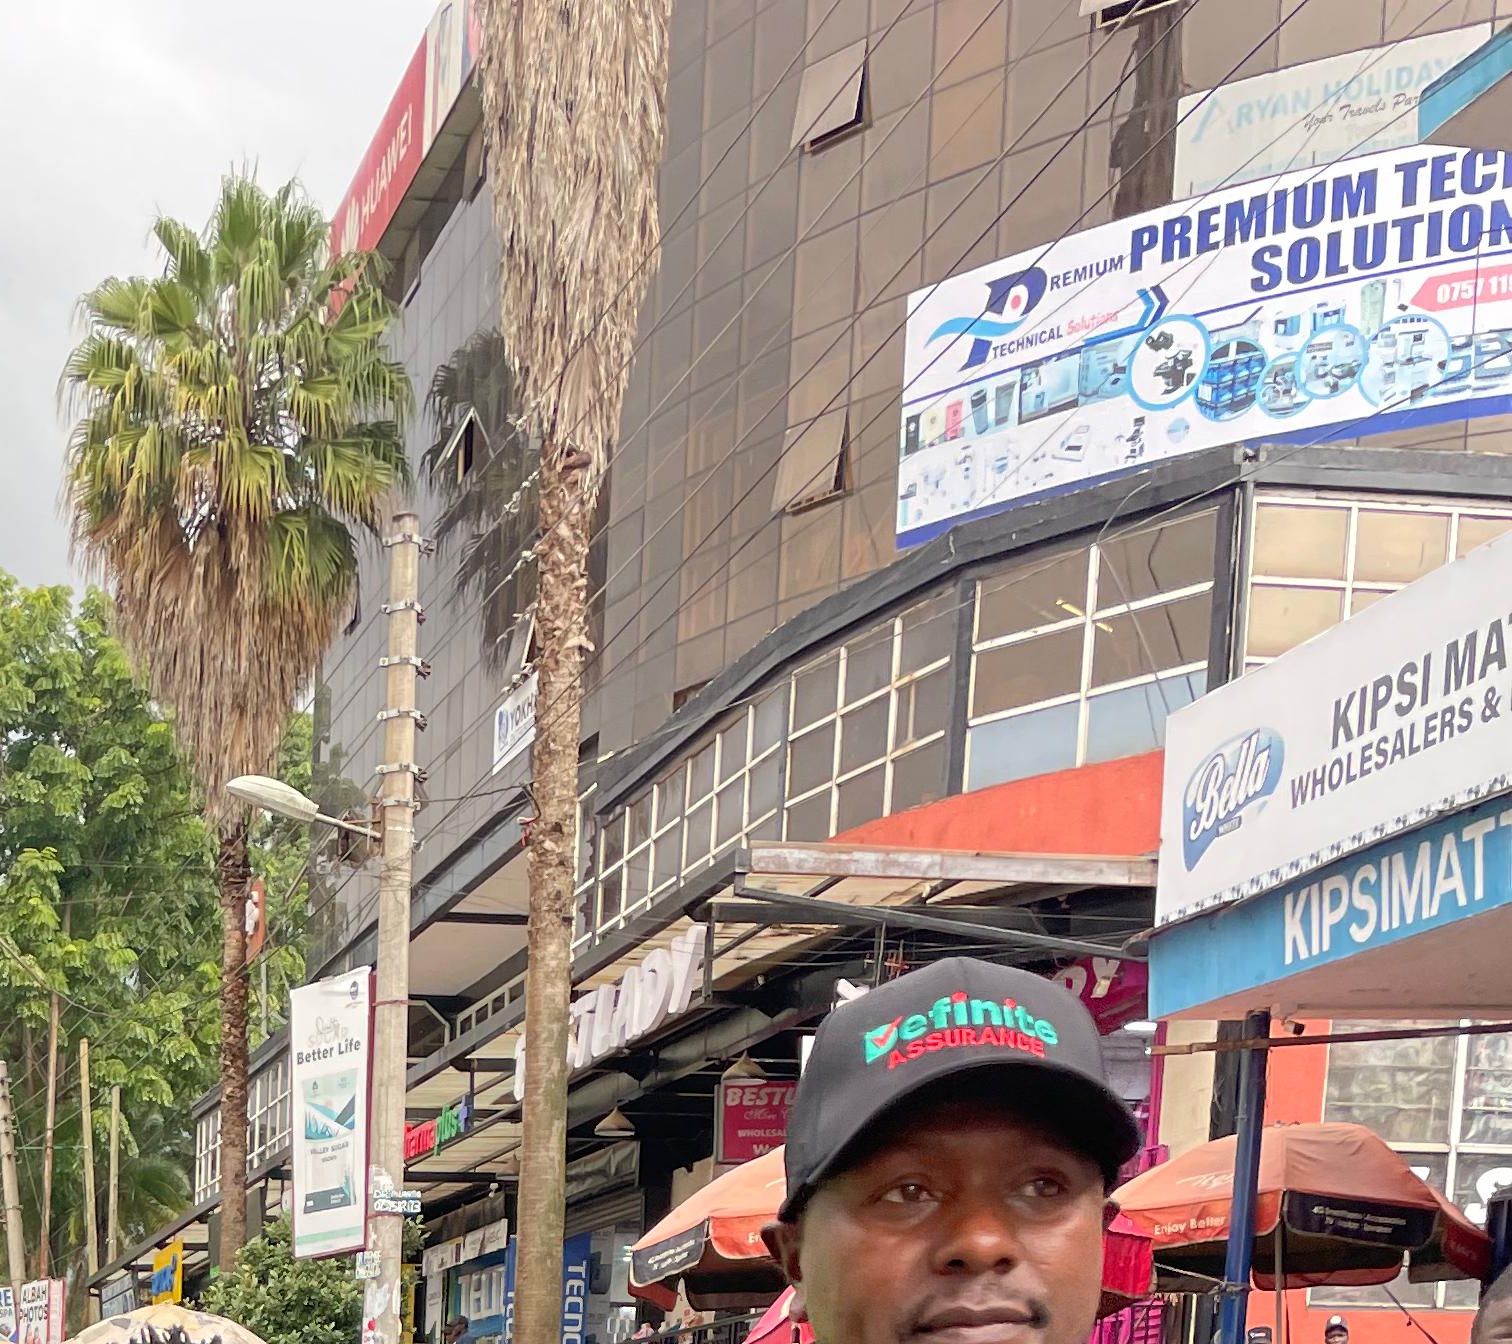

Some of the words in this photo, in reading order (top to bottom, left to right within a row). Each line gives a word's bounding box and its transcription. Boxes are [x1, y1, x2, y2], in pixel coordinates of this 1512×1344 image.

[360, 103, 413, 236] HUAWEI
[1130, 168, 1378, 274] PREMIUM
[1437, 277, 1484, 304] 0757
[991, 327, 1063, 360] TECHNICAL
[1066, 311, 1119, 337] Solutions
[1331, 652, 1432, 751] KIPSI
[1442, 610, 1512, 697] MA
[1290, 696, 1474, 810] WHOLESALERS
[1480, 685, 1502, 723] &
[1189, 727, 1272, 841] Bella
[296, 1046, 334, 1065] Better
[338, 1037, 361, 1055] Life
[864, 991, 1058, 1066] Definite
[887, 1026, 1046, 1070] ASSURANCE
[1153, 1221, 1187, 1236] Enjoy
[1189, 1215, 1226, 1230] Better
[19, 1303, 49, 1323] PHOTOS
